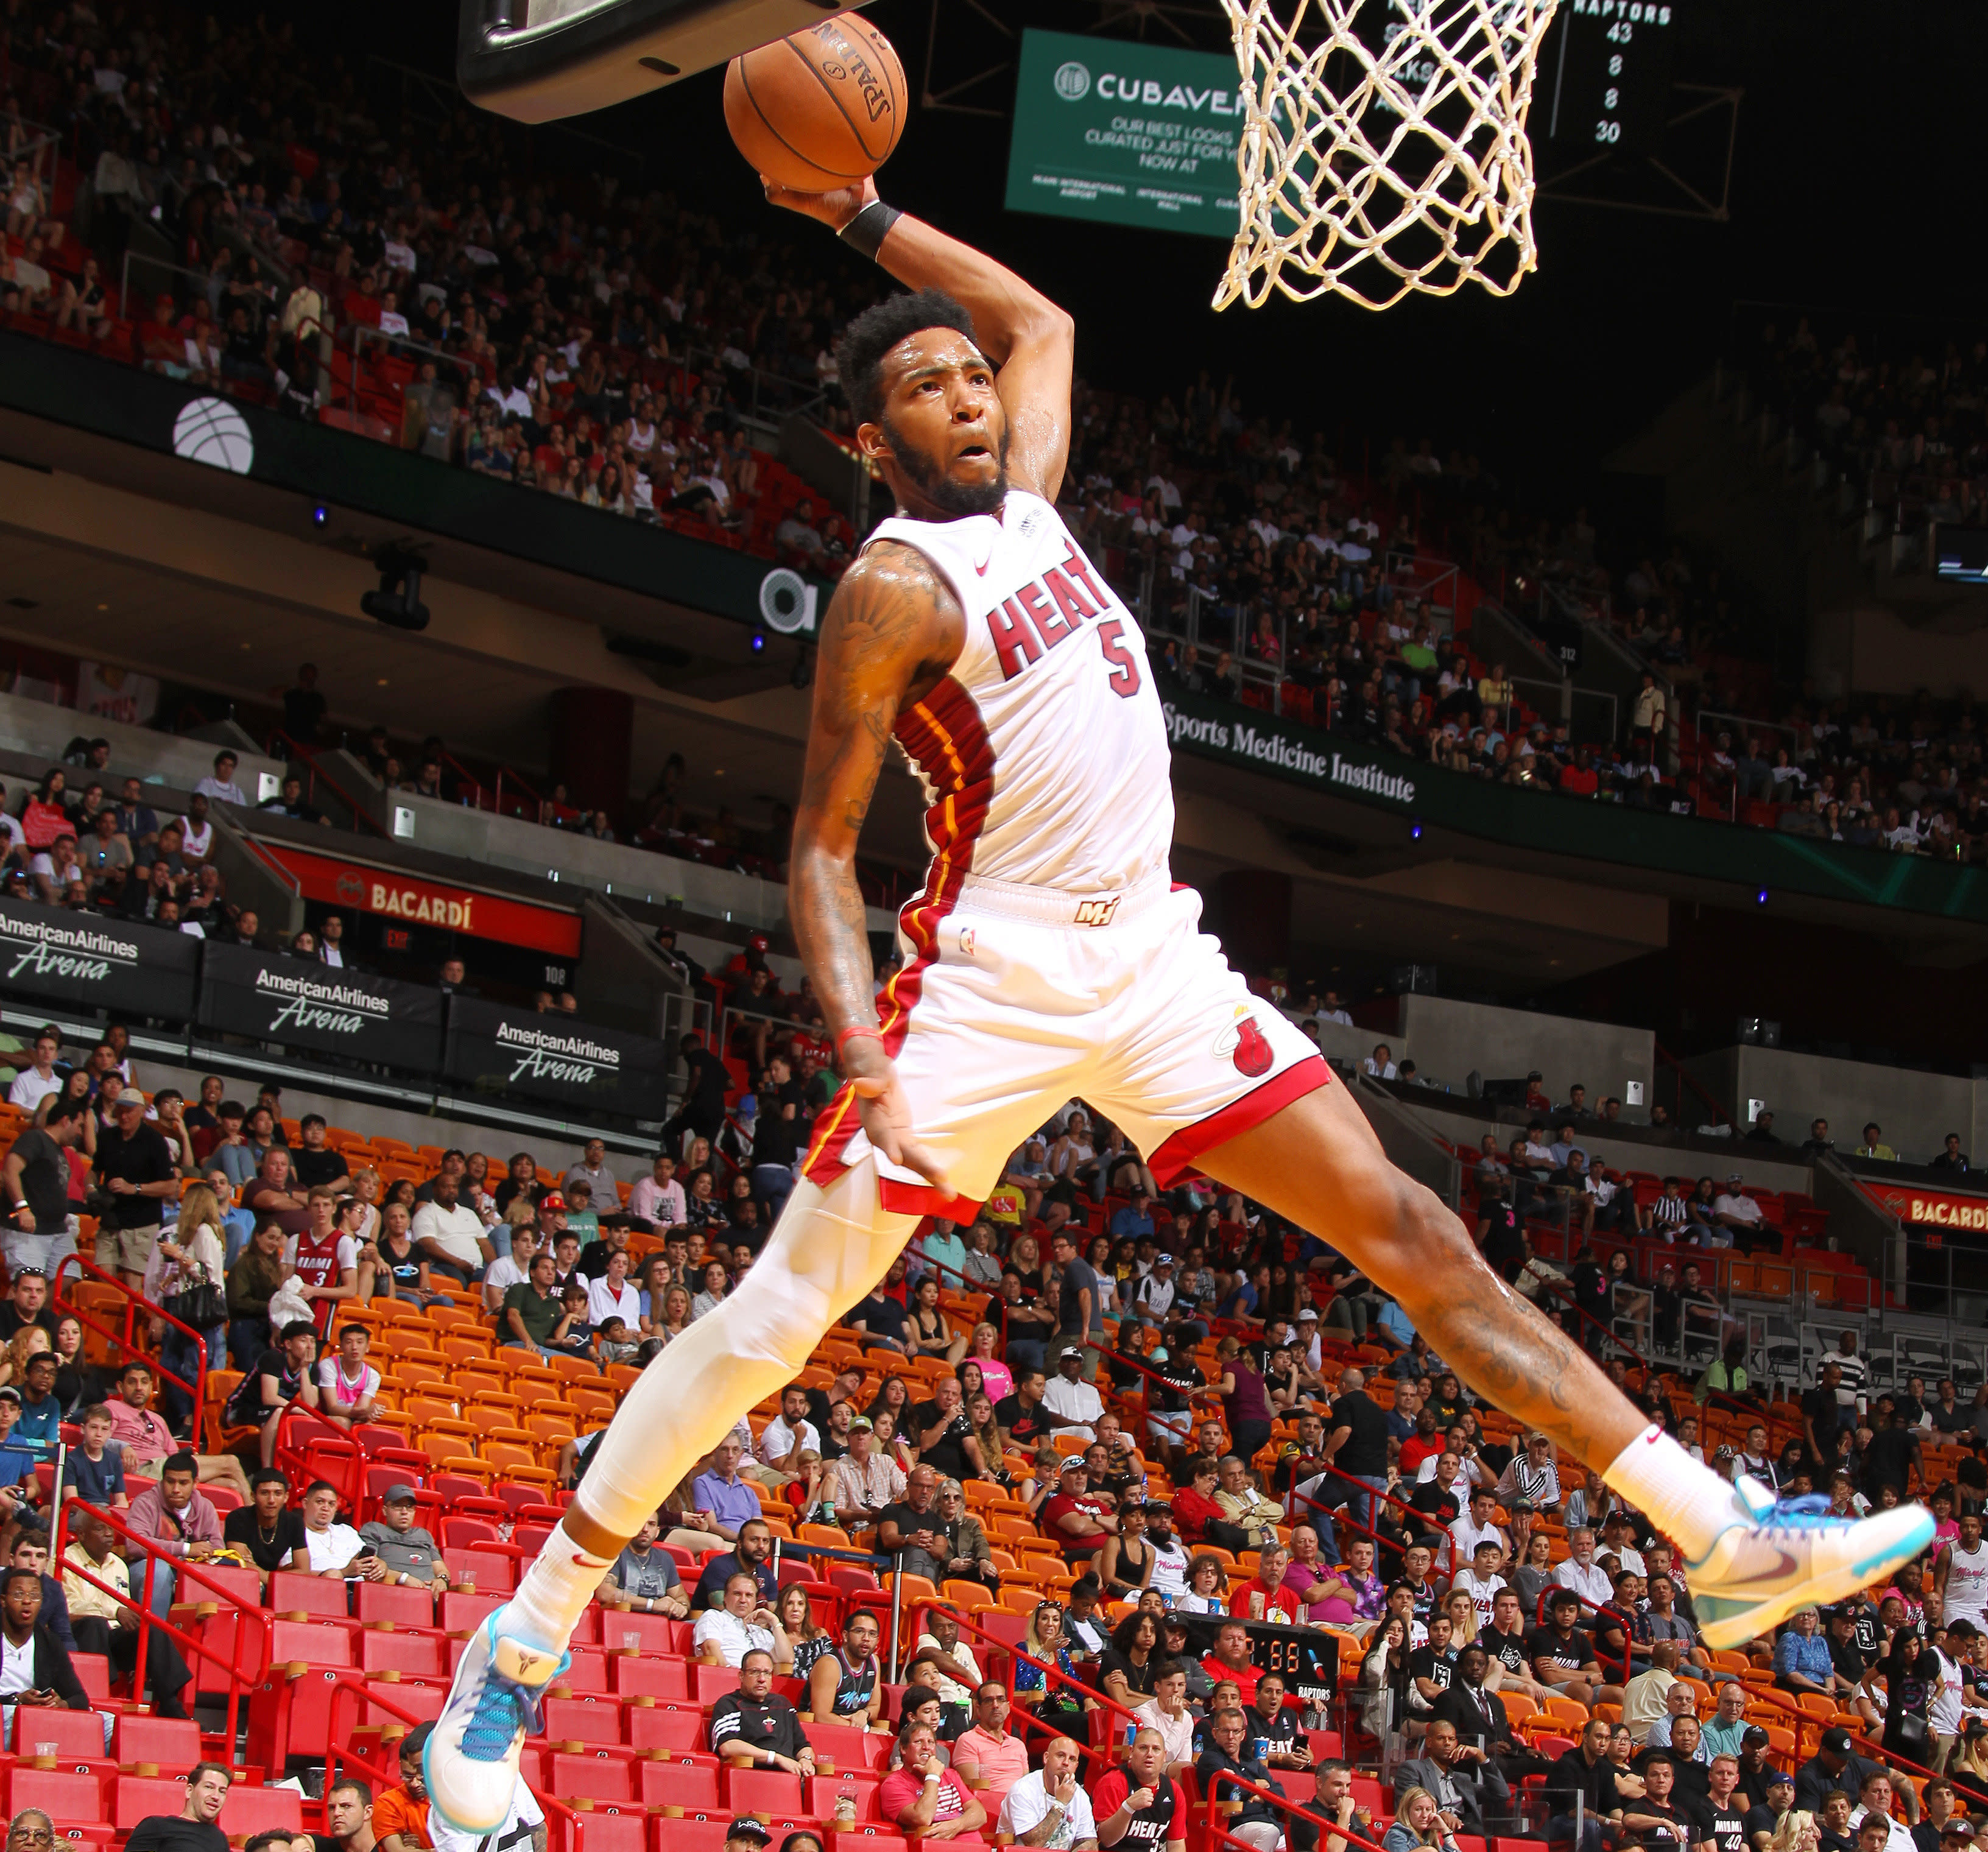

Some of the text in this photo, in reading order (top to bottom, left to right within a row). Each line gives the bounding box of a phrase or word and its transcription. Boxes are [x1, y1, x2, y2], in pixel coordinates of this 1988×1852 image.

[1574, 0, 1671, 25] RAPTORS
[1607, 21, 1632, 44] 43
[811, 23, 891, 122] SPALDIN
[1609, 54, 1623, 77] 8
[1604, 87, 1619, 110] 8
[1111, 116, 1234, 146] OUR BEST LOOKS
[1595, 120, 1621, 143] 30
[1085, 129, 1153, 152] CURATED
[1155, 139, 1190, 156] JUST
[1193, 143, 1223, 160] FOR
[1139, 153, 1199, 174] NOW AT
[986, 535, 1111, 681] HEAT
[1098, 619, 1141, 698] 5
[1162, 702, 1415, 803] Sports Medicine Institute
[372, 884, 473, 929] BACARDÍ
[0, 915, 138, 959] AmericanAirlines
[9, 941, 111, 980] Arena
[256, 969, 390, 1013] AmericanAirlines
[270, 996, 365, 1033] Arena
[496, 1021, 620, 1063] AmericanAirlines
[509, 1047, 597, 1084] Arena
[1504, 1211, 1512, 1227] 3
[296, 1256, 333, 1270] MIAMI
[314, 1271, 327, 1287] 3
[1597, 1276, 1607, 1294] 3
[1973, 1579, 1980, 1590] 3
[1860, 1628, 1869, 1642] 3
[1298, 1686, 1331, 1701] RAPTORS
[1127, 1819, 1170, 1839] HEAT
[1715, 1820, 1743, 1834] MIAMI
[1725, 1834, 1742, 1850] 40
